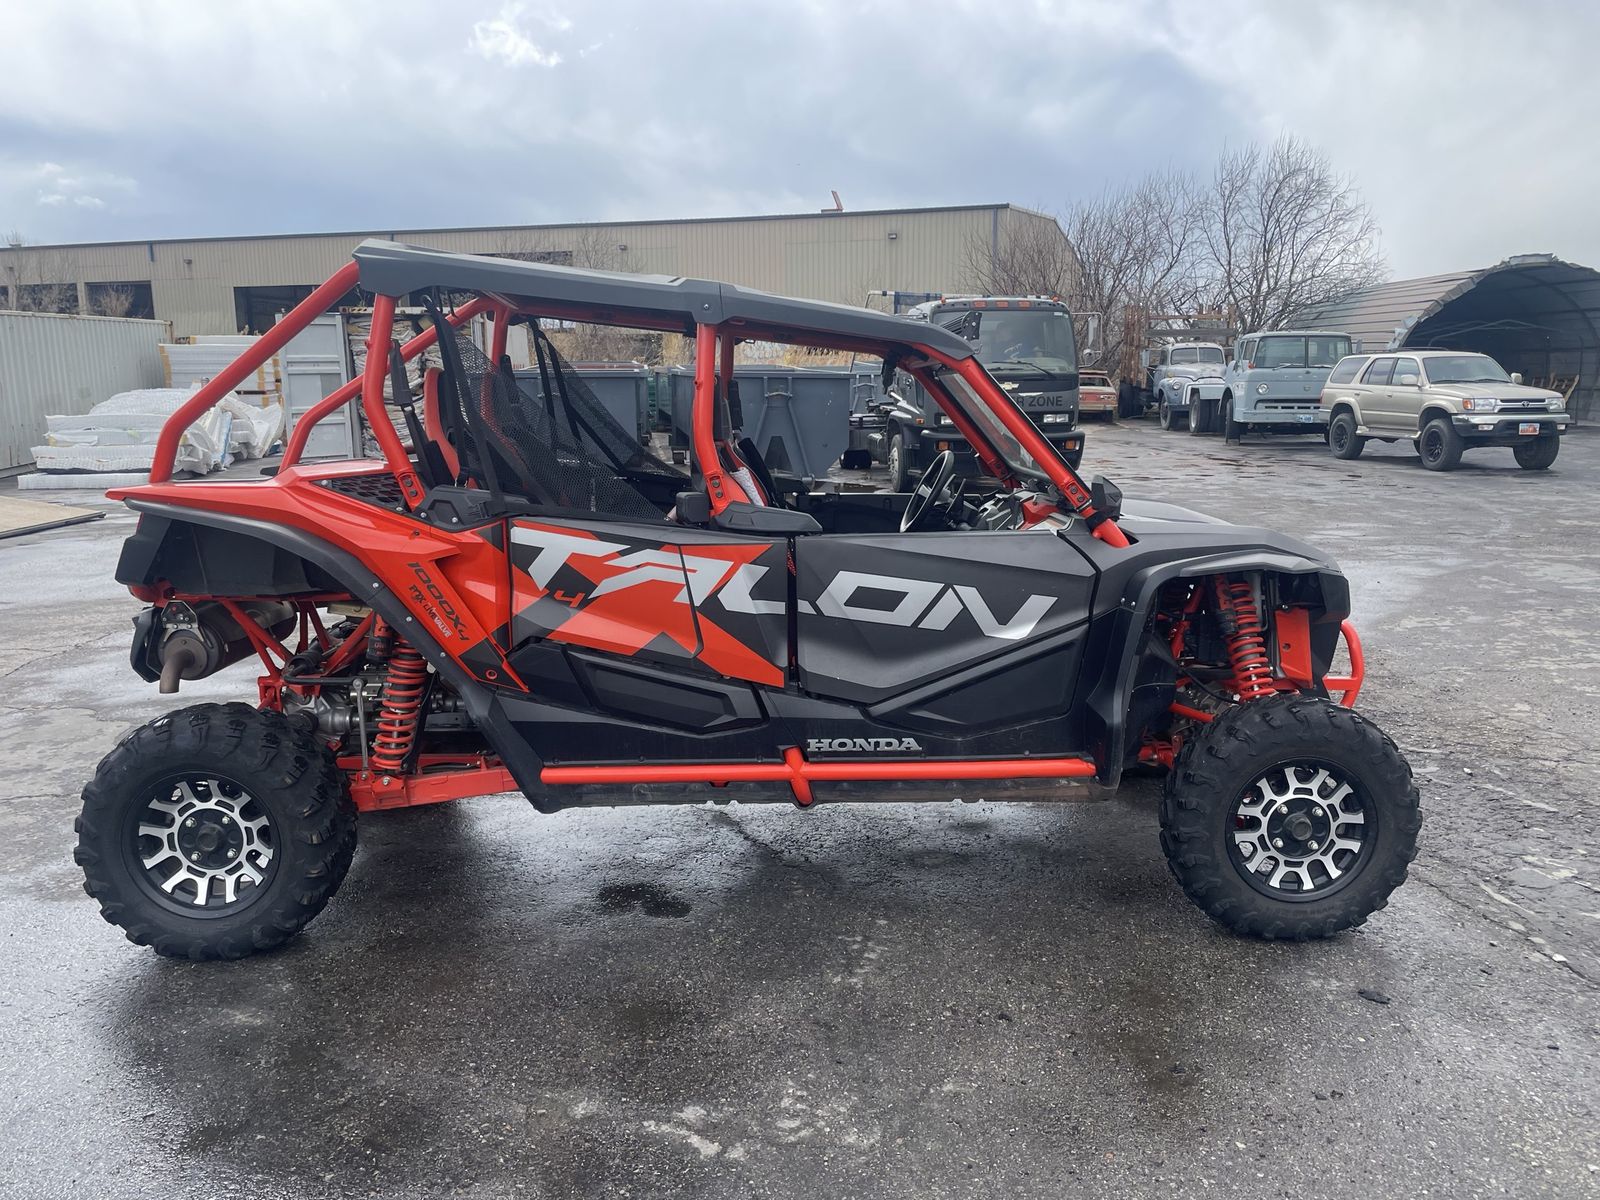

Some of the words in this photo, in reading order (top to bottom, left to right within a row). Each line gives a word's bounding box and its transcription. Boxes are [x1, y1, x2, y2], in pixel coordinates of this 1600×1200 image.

[1028, 395, 1063, 407] ZONE
[510, 526, 1058, 640] TALON
[553, 590, 585, 607] 4
[807, 738, 922, 752] HONDA
